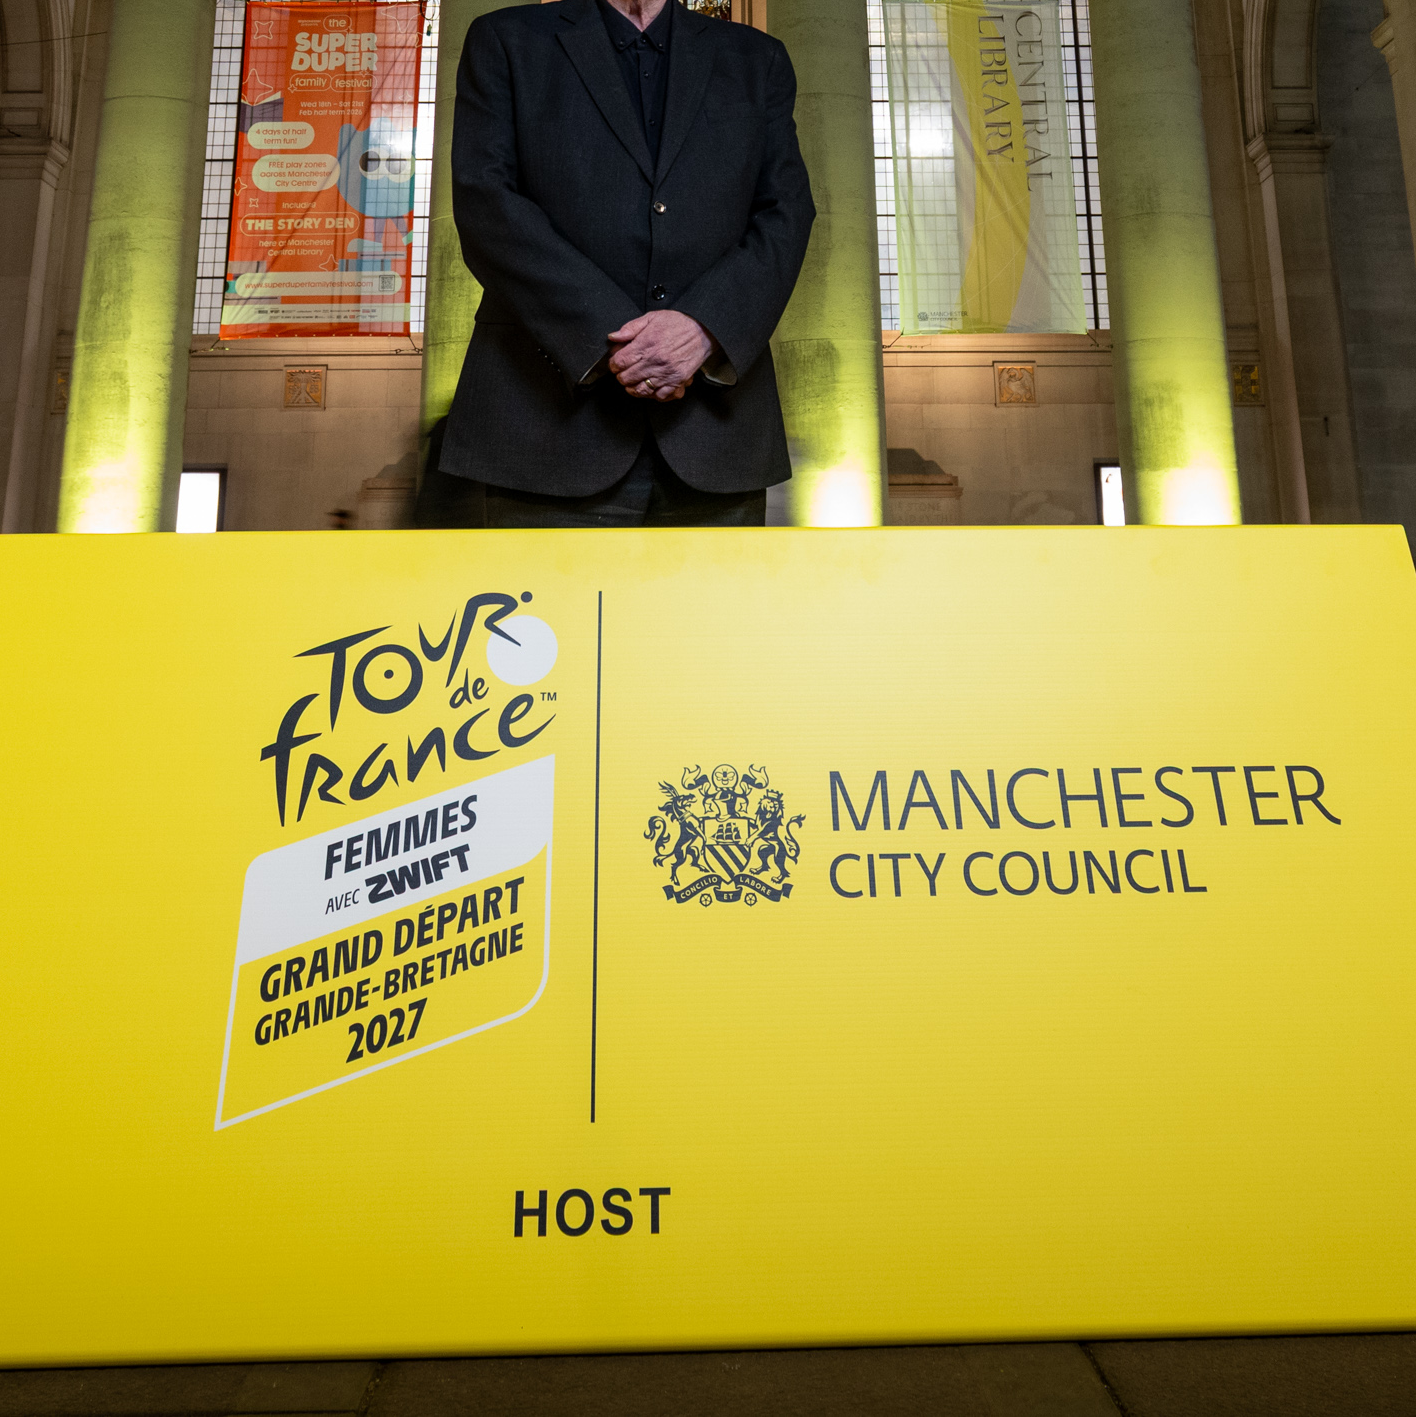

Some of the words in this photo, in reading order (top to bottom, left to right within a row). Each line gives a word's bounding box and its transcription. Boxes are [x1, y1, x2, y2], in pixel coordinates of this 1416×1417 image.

[295, 32, 378, 53] SUPER
[329, 19, 347, 28] the
[291, 51, 378, 72] DUPER
[295, 77, 327, 88] family
[335, 78, 372, 88] festival
[978, 14, 1014, 163] LIBRARY
[1015, 11, 1053, 192] CENTRAL
[246, 219, 273, 231] THE
[277, 218, 322, 230] STORY
[325, 218, 355, 229] DEN
[297, 248, 324, 256] Library
[294, 592, 532, 731] TOUR
[450, 669, 490, 708] de
[830, 766, 1341, 831] MANCHESTER
[324, 795, 478, 880] FEMMES
[325, 888, 360, 915] AVEC
[365, 844, 470, 904] ZWIFT
[680, 876, 718, 899] CONCILIO
[739, 876, 772, 896] LABORE
[830, 853, 946, 898] CITY
[963, 849, 1208, 897] COUNCIL
[260, 930, 383, 1003] GRAND
[394, 877, 525, 957] DÉPART
[255, 923, 524, 1046] GRANDE-BRETAGNE
[346, 998, 428, 1064] 2027
[514, 1187, 671, 1238] HOST
